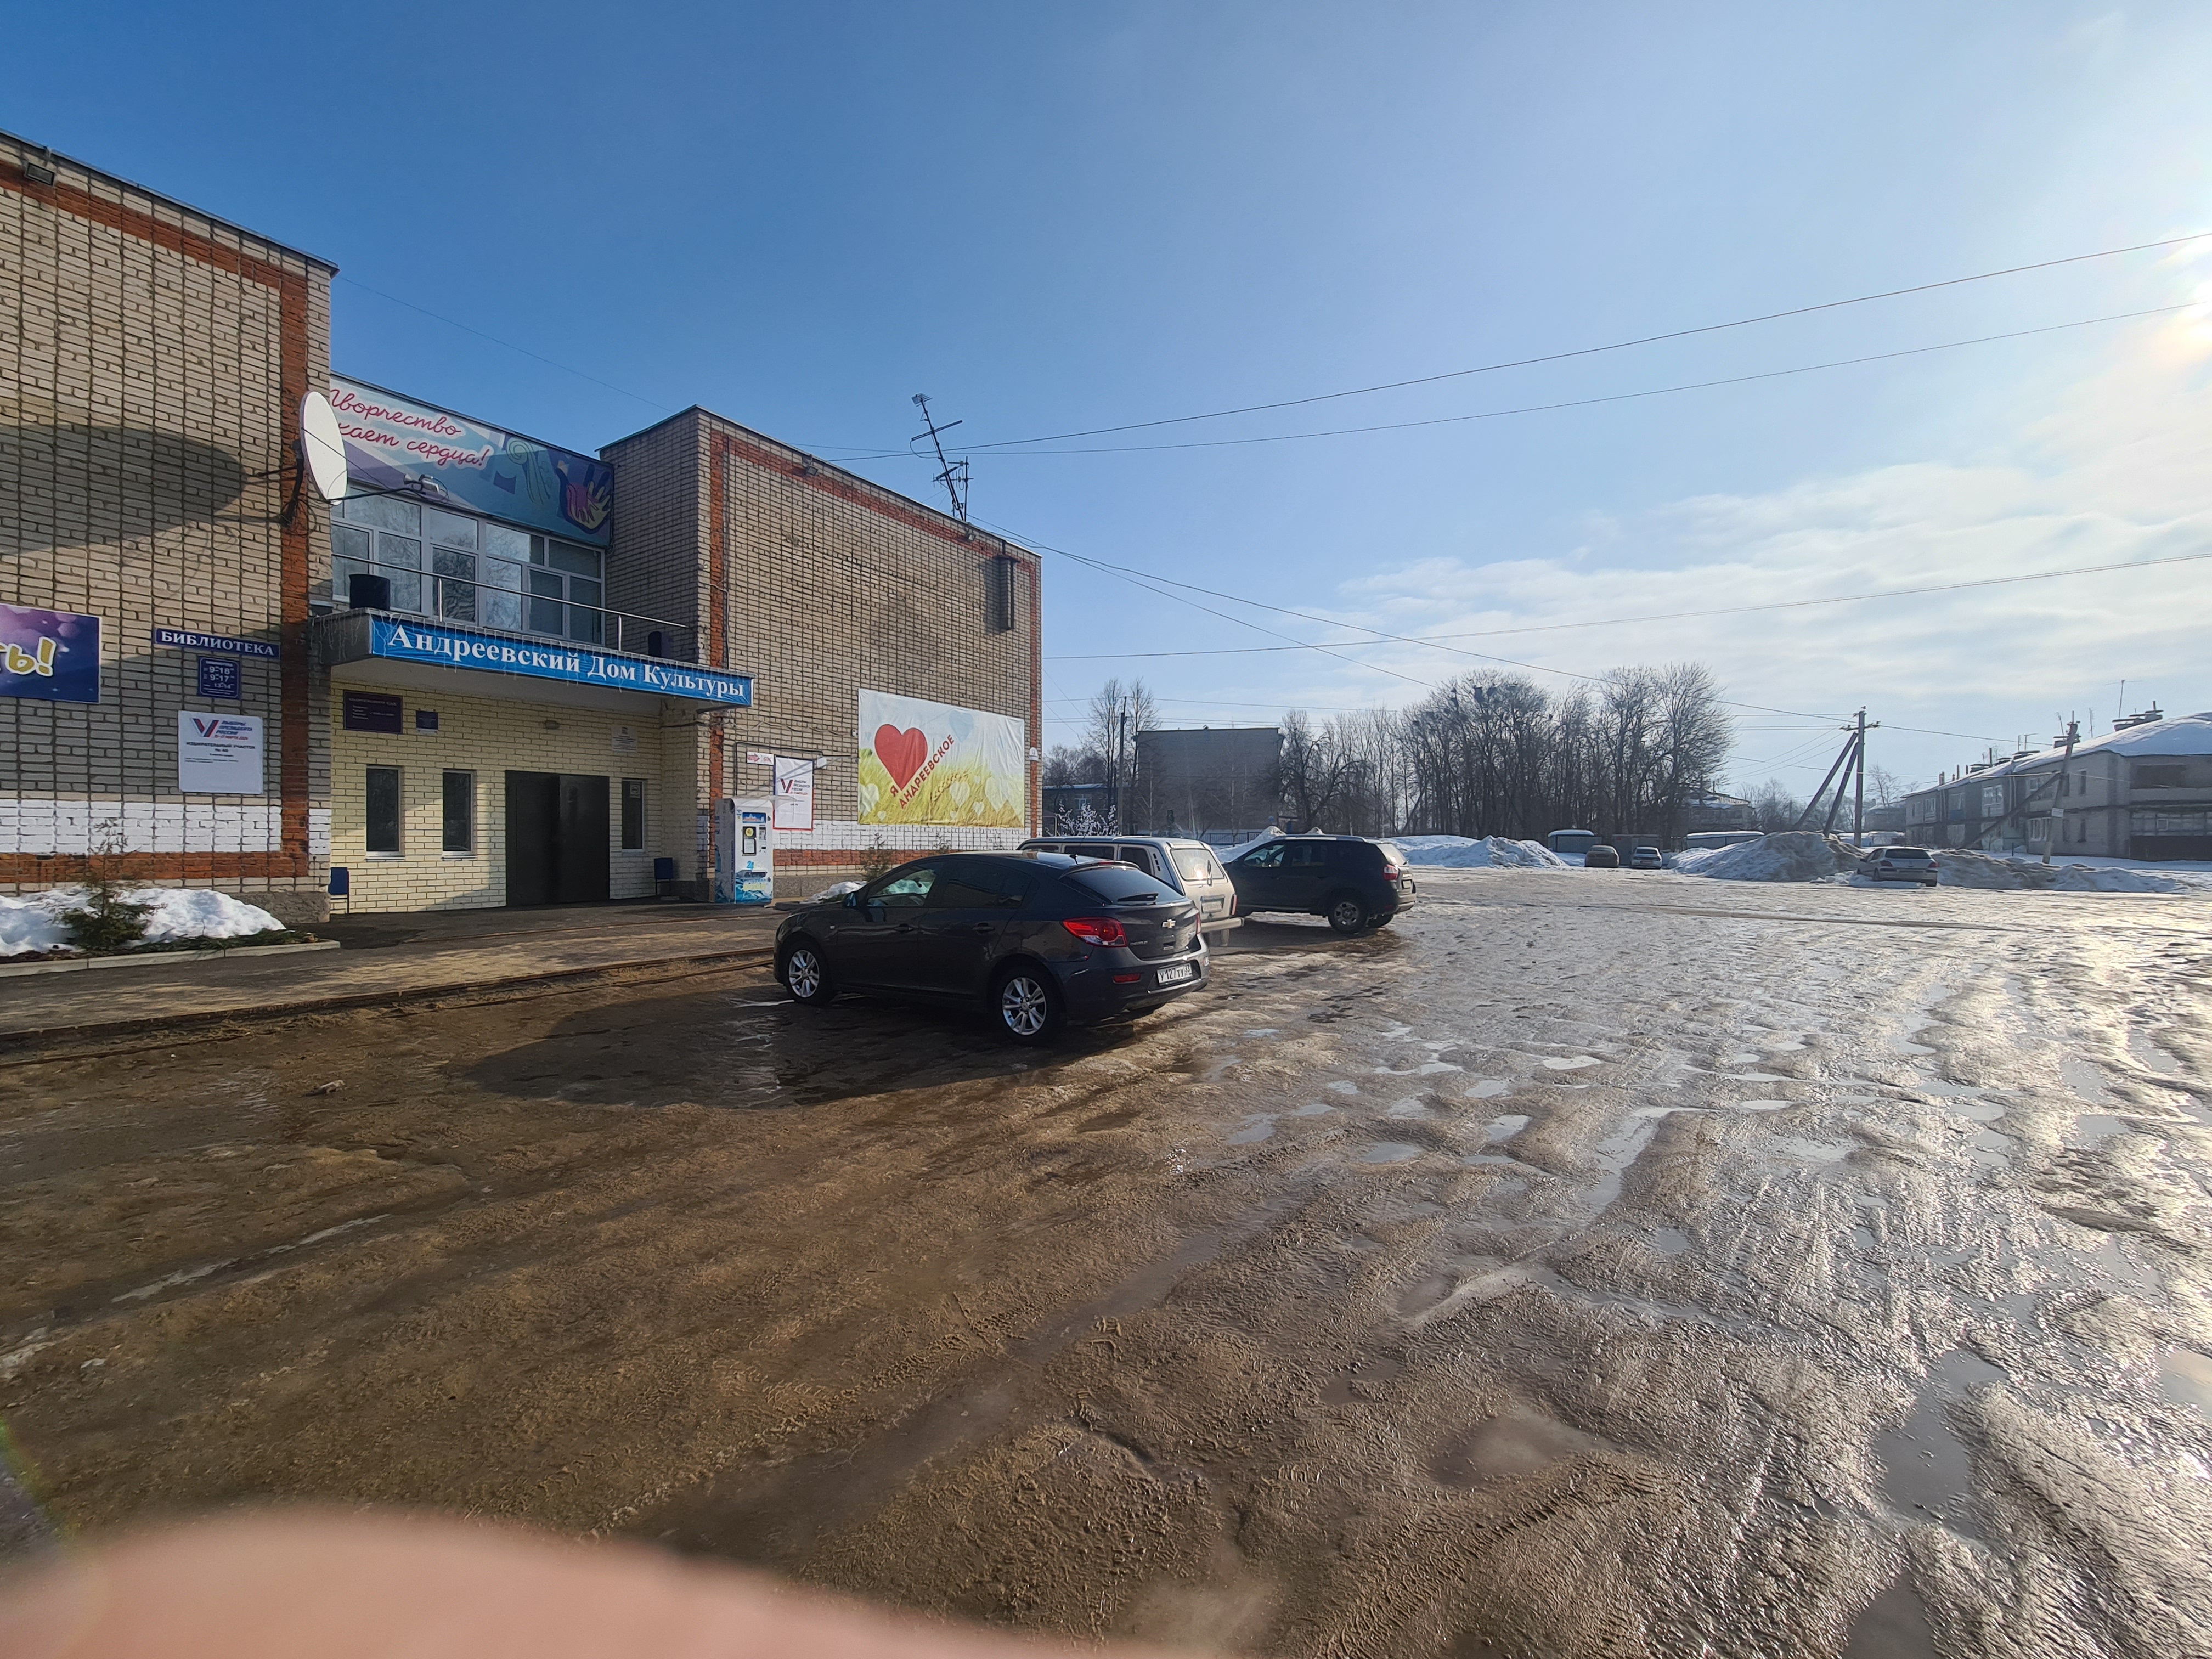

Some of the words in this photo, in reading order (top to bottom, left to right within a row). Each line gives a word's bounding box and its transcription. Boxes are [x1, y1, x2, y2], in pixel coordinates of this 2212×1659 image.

[407, 441, 489, 466] сердца!
[0, 637, 56, 676] ь!
[161, 631, 275, 656] БИБЛИОТЕКА
[388, 624, 580, 673] Андреевский
[587, 656, 635, 681] Дом
[644, 664, 746, 698] Культуры
[899, 734, 955, 809] АНДРЕЕВСКОЕ
[890, 785, 899, 797] Я
